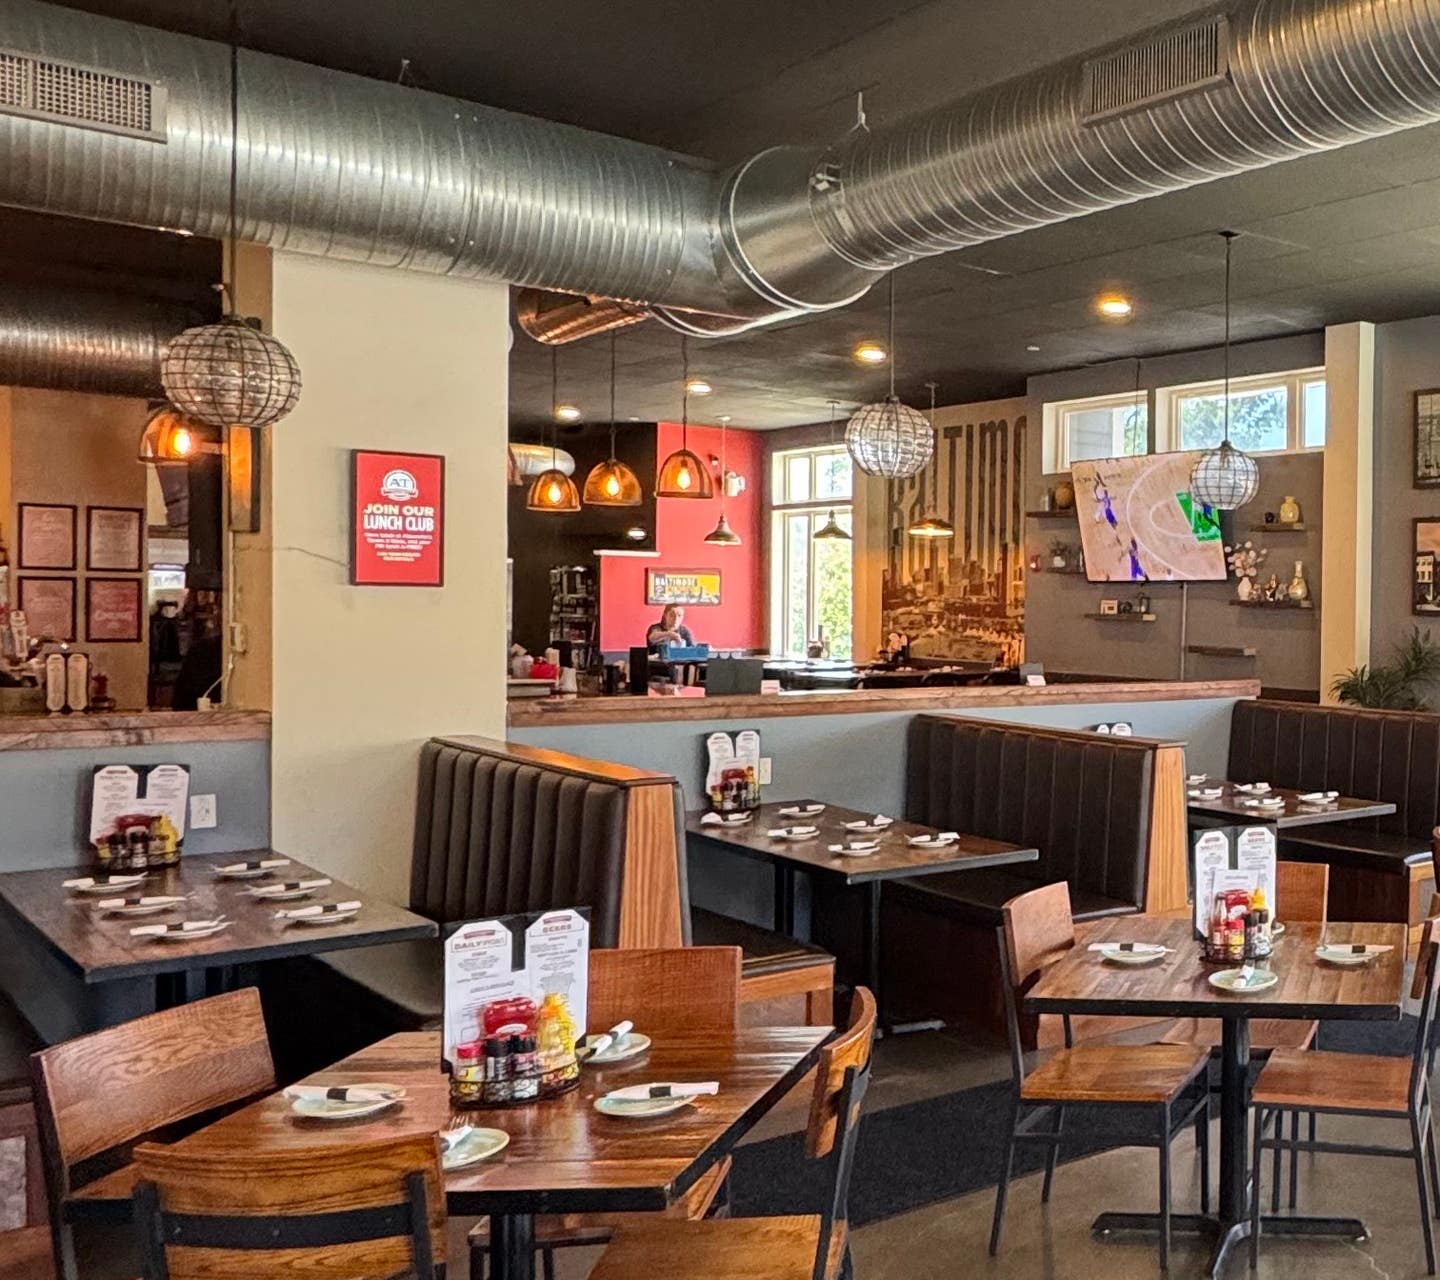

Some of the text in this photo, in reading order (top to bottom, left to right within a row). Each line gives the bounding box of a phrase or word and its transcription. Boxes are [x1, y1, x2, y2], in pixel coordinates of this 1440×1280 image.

[364, 504, 434, 516] JOIN OUR
[363, 516, 434, 531] LUNCH CLUB
